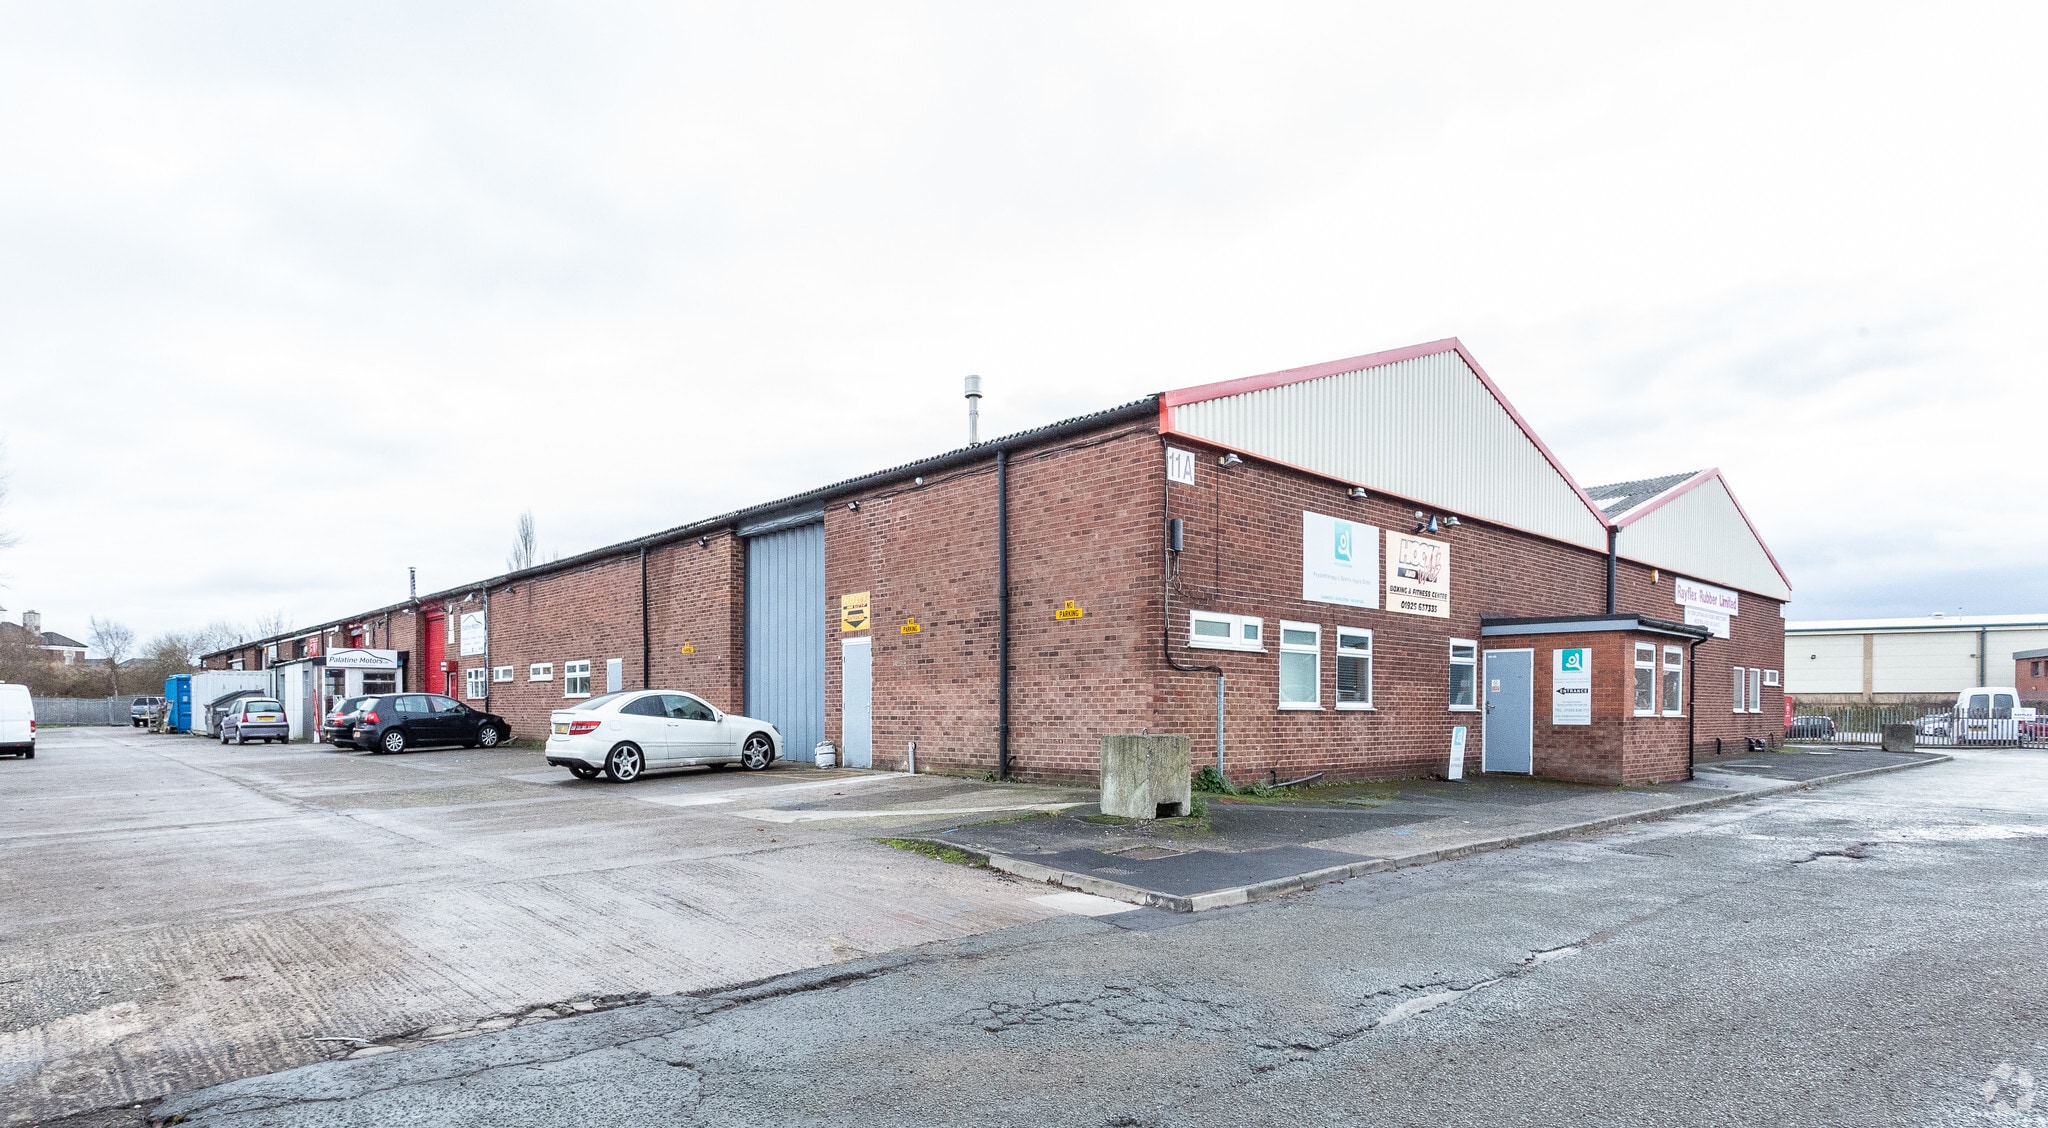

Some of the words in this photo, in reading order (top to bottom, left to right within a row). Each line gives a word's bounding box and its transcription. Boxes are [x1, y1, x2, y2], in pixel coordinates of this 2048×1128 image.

[1169, 452, 1193, 481] 11A
[1390, 585, 1407, 594] BOXING
[1412, 589, 1431, 597] FITNESS
[1431, 592, 1447, 600] CENTRE
[1677, 584, 1697, 602] Rayflex
[1699, 589, 1717, 606] Rubber
[1719, 594, 1737, 610] Limited
[1066, 601, 1074, 609] NO
[1401, 601, 1417, 610] 01925
[1059, 609, 1080, 618] PARKING
[329, 656, 358, 664] Palatine
